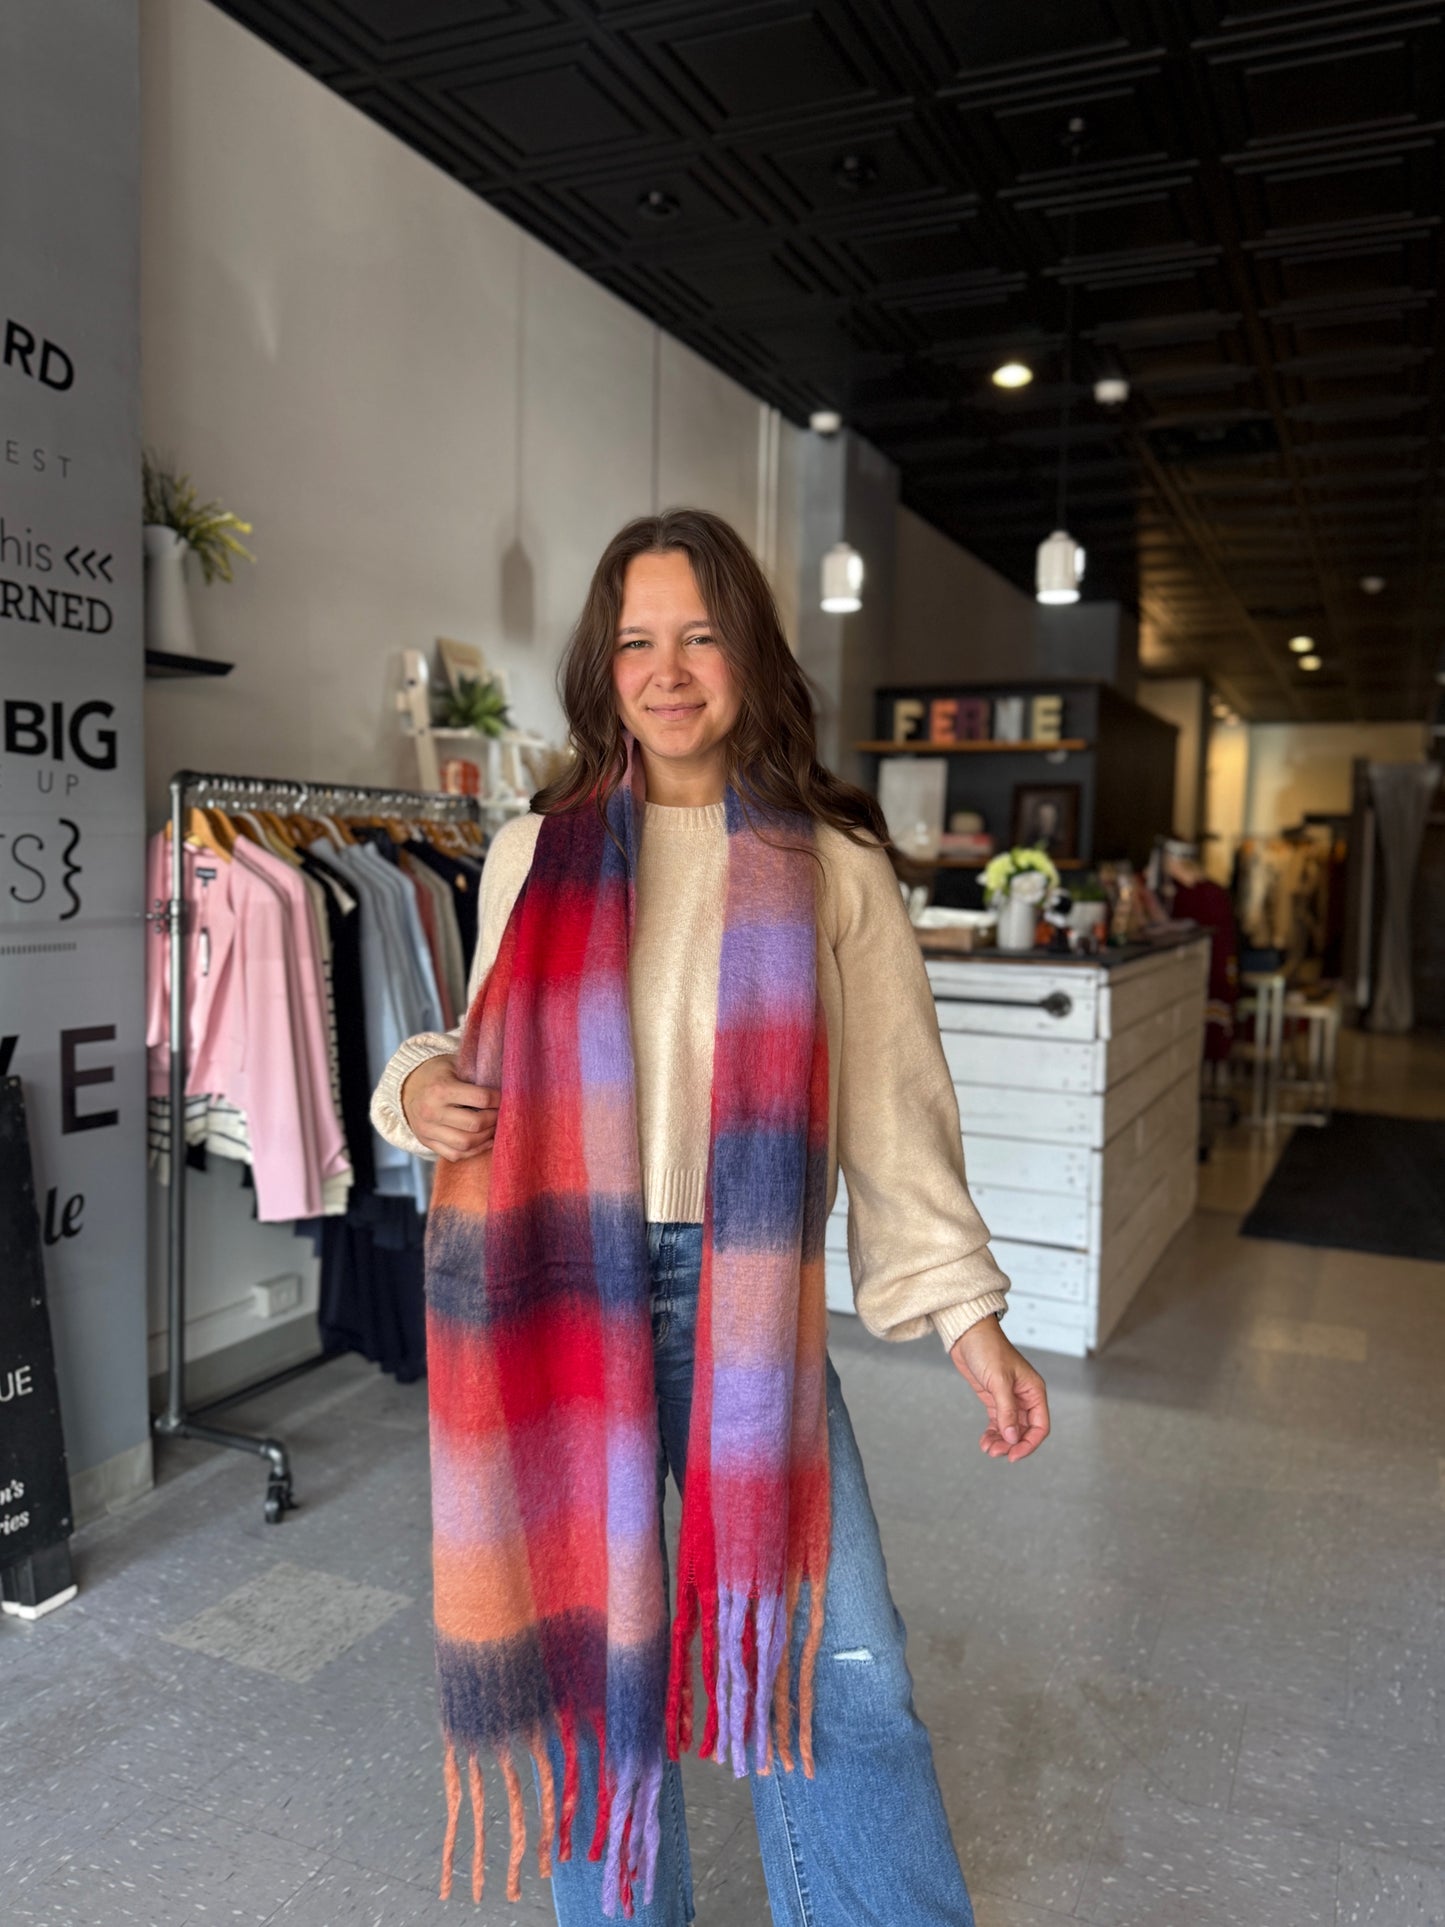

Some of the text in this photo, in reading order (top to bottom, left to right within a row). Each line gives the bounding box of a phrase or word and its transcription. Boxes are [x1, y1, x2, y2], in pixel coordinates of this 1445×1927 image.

[0, 578, 113, 634] RNED
[4, 699, 117, 770] BIG
[0, 833, 46, 903] S
